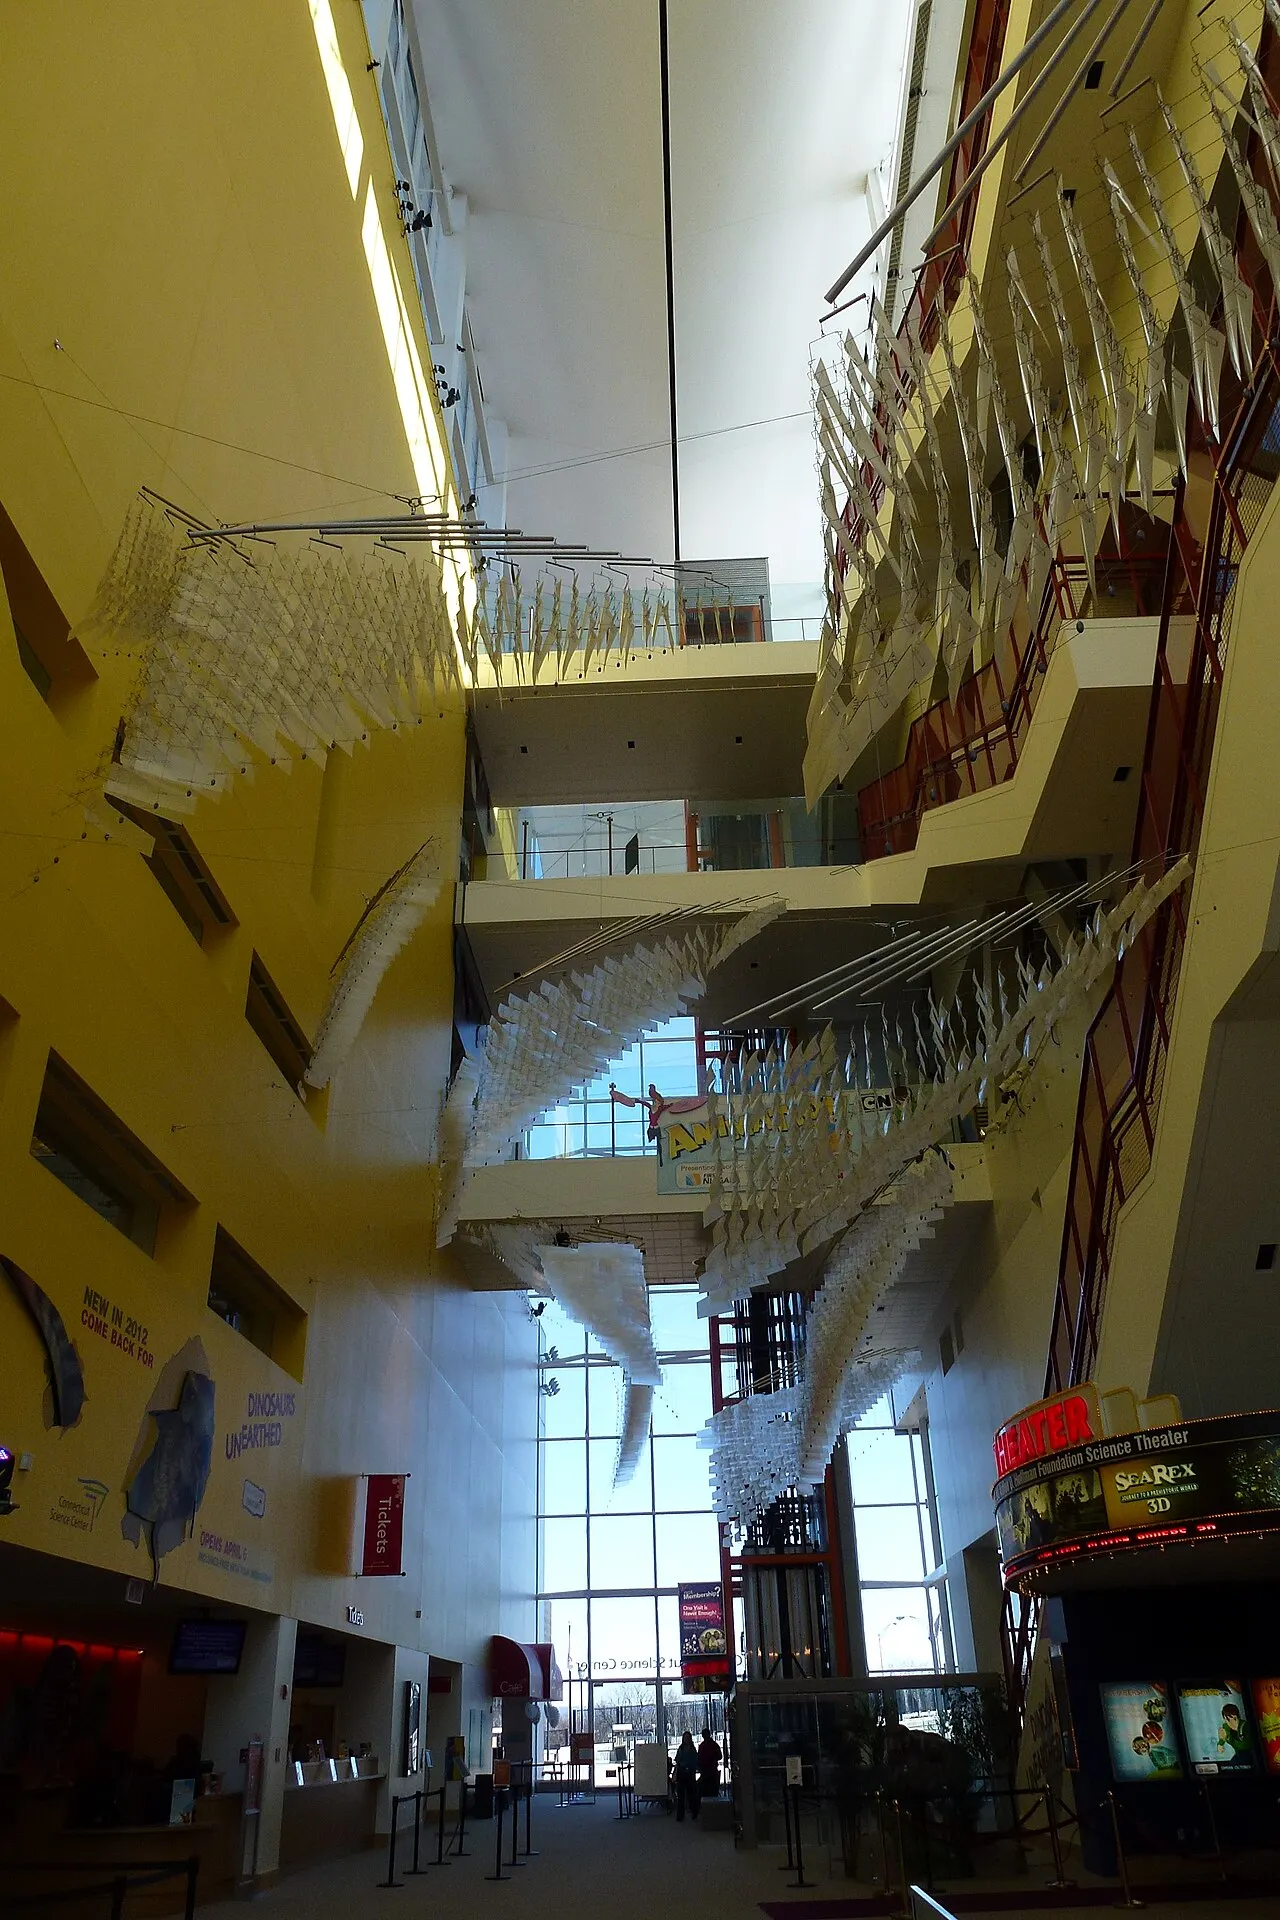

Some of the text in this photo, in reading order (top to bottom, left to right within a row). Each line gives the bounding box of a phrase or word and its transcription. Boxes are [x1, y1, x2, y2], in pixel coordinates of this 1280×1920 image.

[862, 1094, 892, 1111] CN
[83, 1285, 148, 1345] NEW IN 2012
[81, 1308, 154, 1369] COME BACK FOR
[248, 1392, 296, 1417] DINOSAURS
[225, 1422, 282, 1460] UNEARTHED
[1037, 1449, 1083, 1477] Foundation
[1085, 1440, 1132, 1462] Science
[1133, 1429, 1189, 1451] Theater
[376, 1496, 391, 1554] Tickets
[1147, 1497, 1171, 1514] 3D
